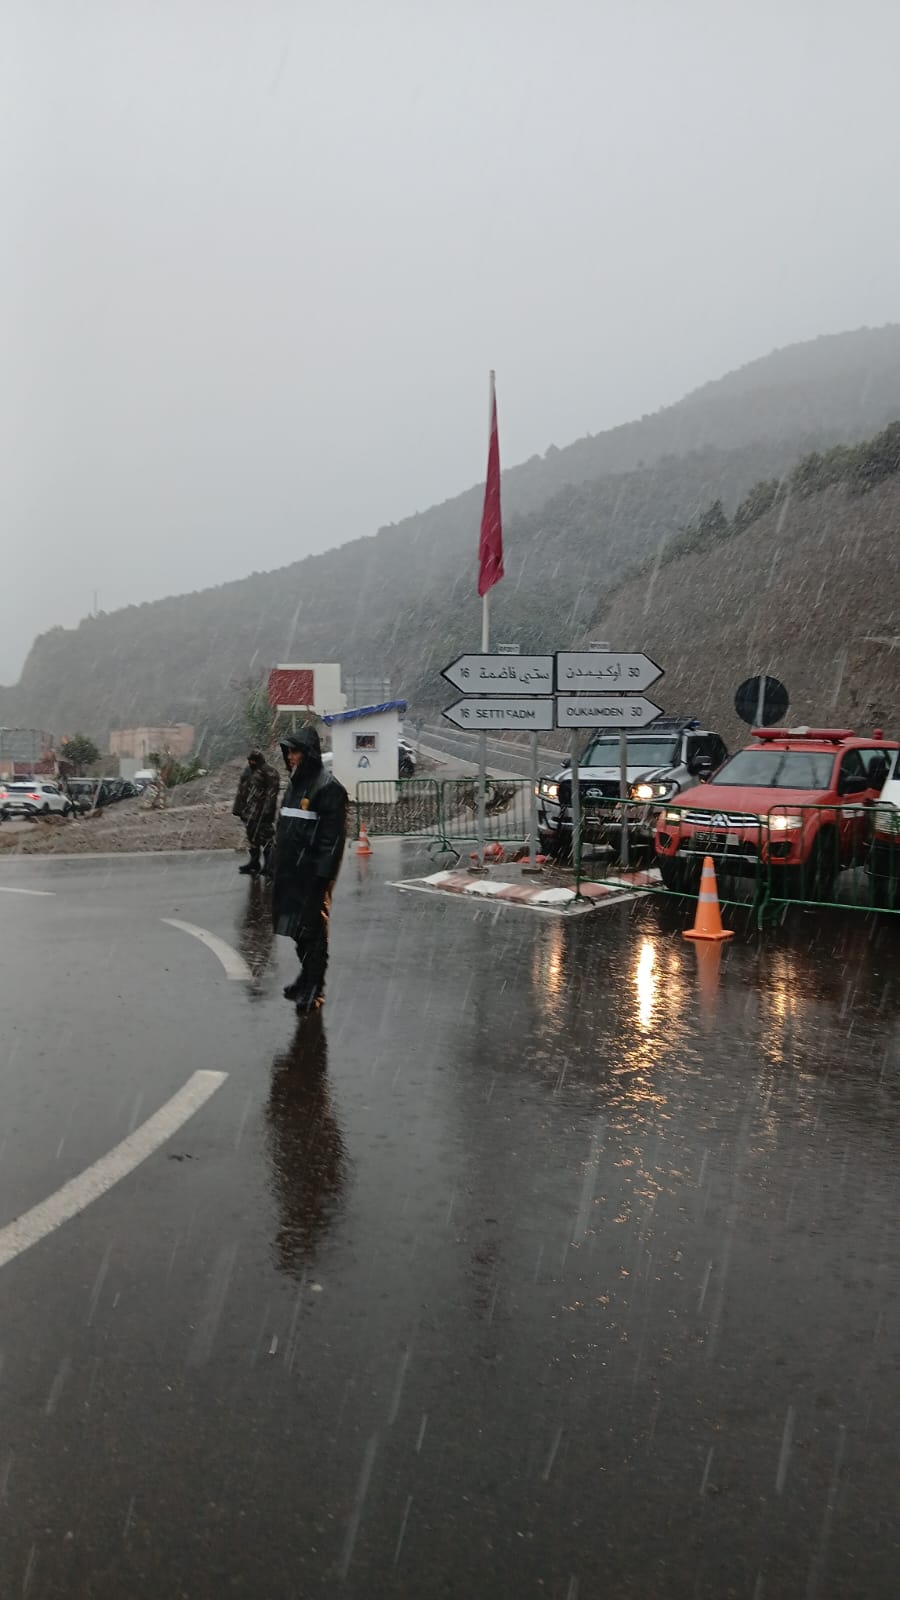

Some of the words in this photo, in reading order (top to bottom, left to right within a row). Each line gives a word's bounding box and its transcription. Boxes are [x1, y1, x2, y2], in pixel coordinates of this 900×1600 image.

[460, 667, 470, 679] 16
[460, 708, 470, 719] 16
[475, 708, 505, 719] SETTI
